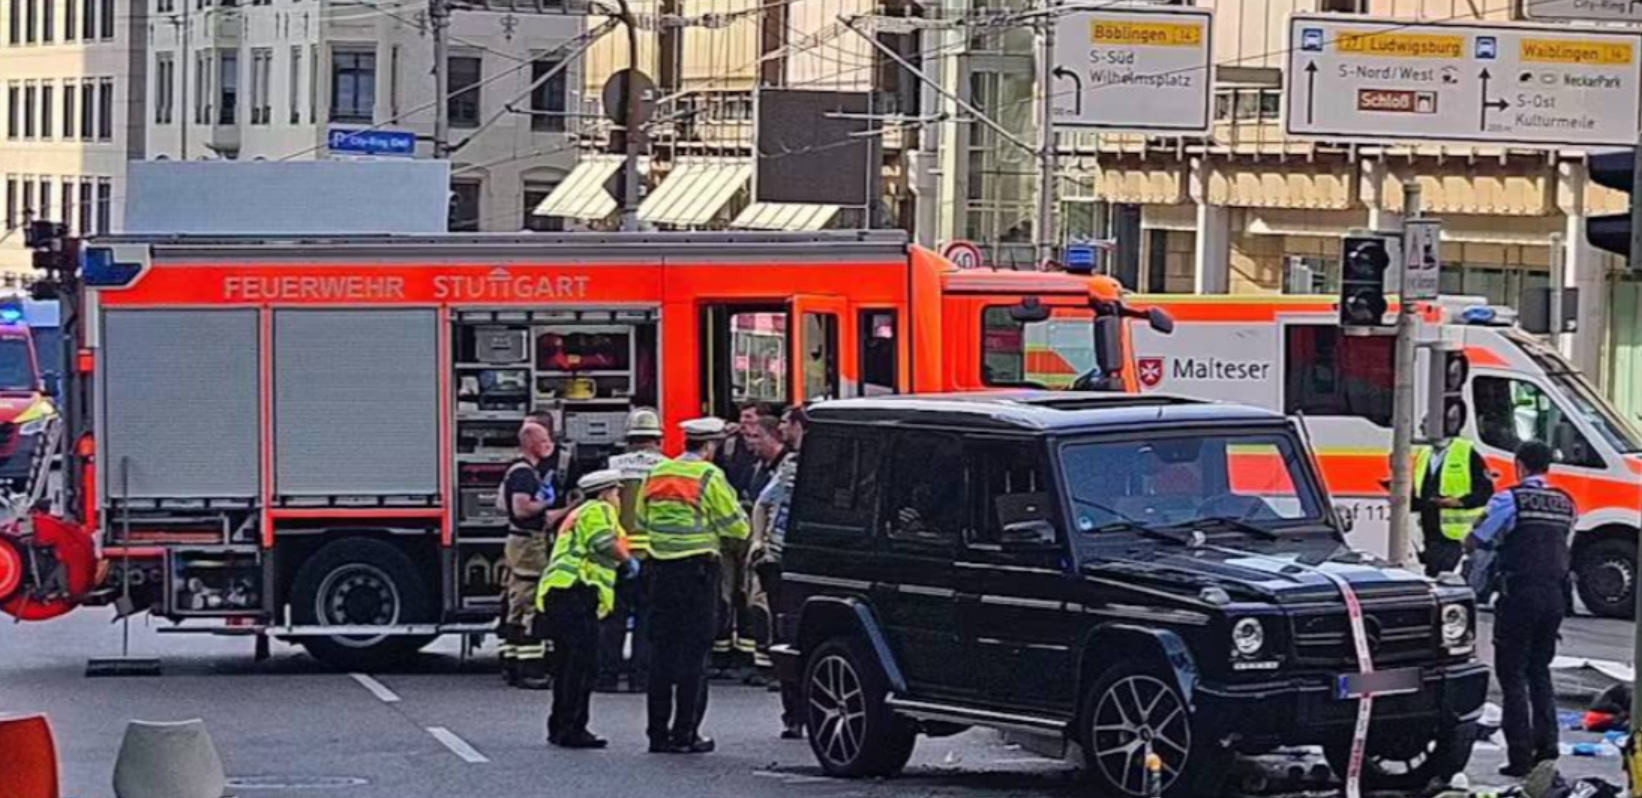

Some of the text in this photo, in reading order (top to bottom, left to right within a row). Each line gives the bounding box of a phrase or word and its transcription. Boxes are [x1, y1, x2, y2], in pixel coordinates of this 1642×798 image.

[1094, 24, 1167, 43] Böblingen
[1370, 38, 1461, 56] Ludwigsburg
[1522, 43, 1599, 62] Waiblingen
[1089, 50, 1134, 65] S-Süd
[1089, 69, 1192, 88] Wilhelmsplatz
[1338, 64, 1434, 81] S-Nord/West
[1564, 74, 1620, 88] NeckarPark
[1360, 92, 1410, 109] Schloß
[1516, 94, 1555, 108] S-Ost
[1515, 113, 1595, 129] Kulturmeile
[223, 274, 590, 300] FEUERWEHR STUTTGART
[1172, 357, 1270, 380] Malteser
[1366, 505, 1390, 521] 11
